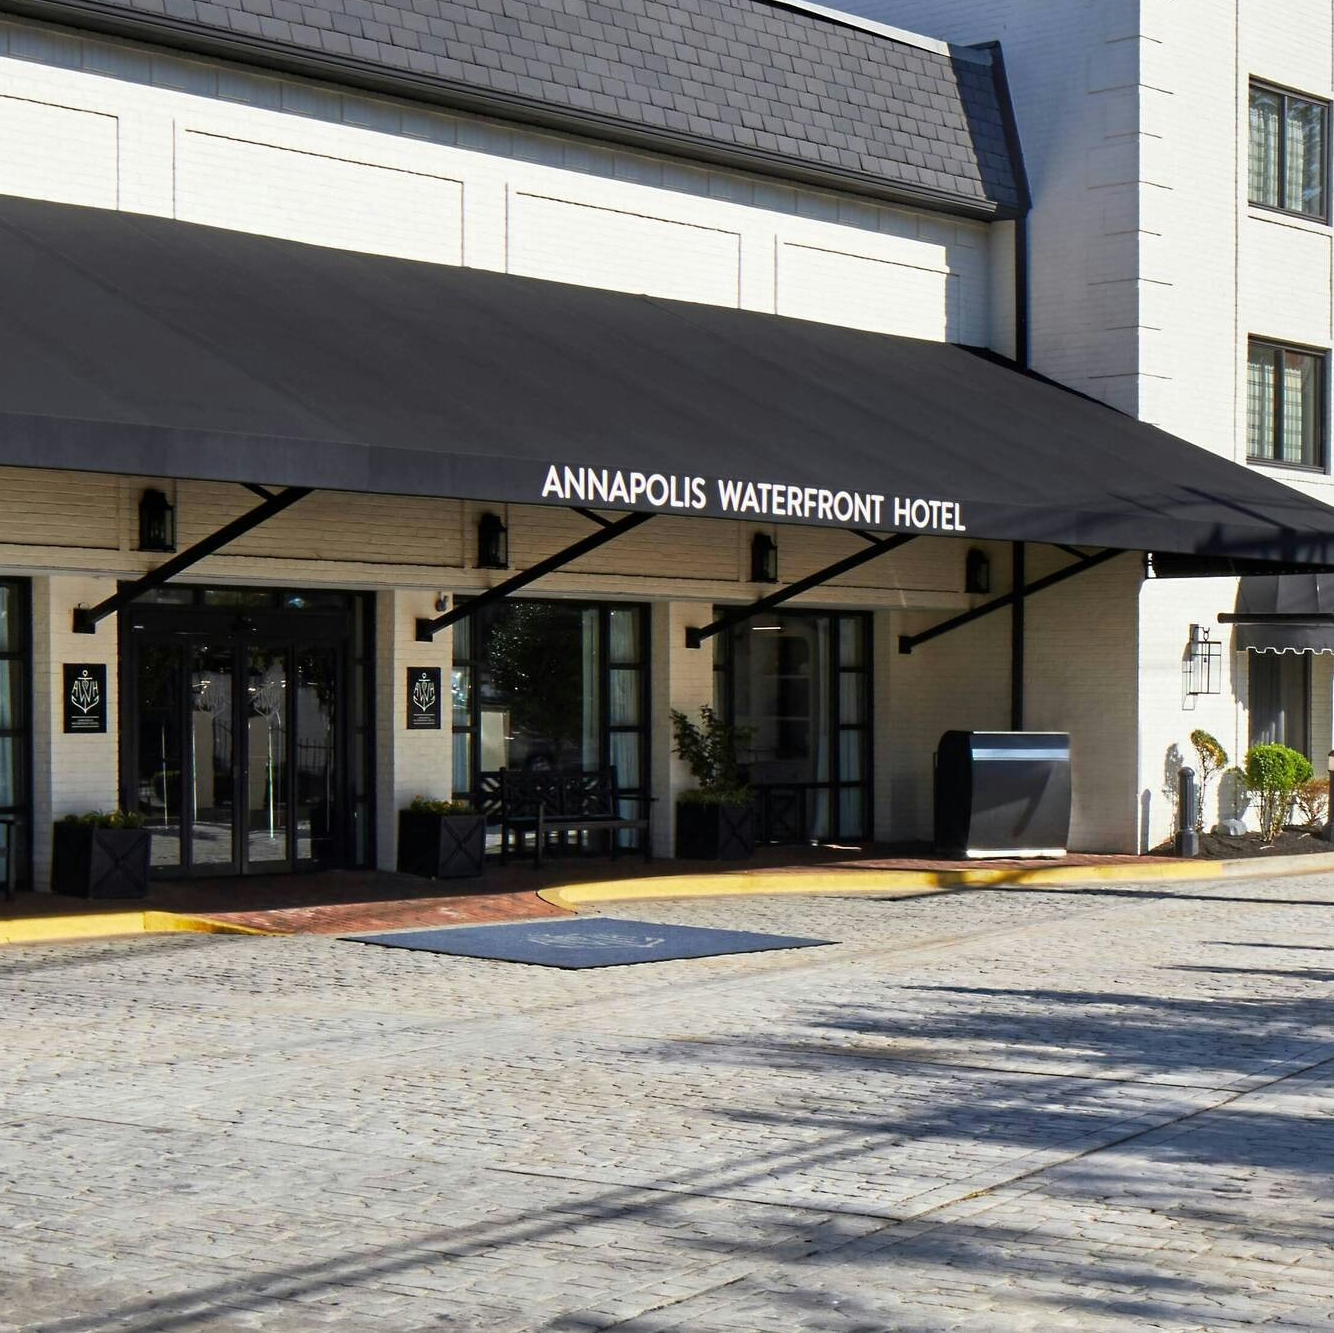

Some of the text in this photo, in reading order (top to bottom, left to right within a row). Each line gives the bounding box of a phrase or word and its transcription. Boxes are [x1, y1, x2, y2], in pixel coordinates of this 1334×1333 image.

[541, 464, 967, 532] ANNAPOLIS WATERFRONT HOTEL
